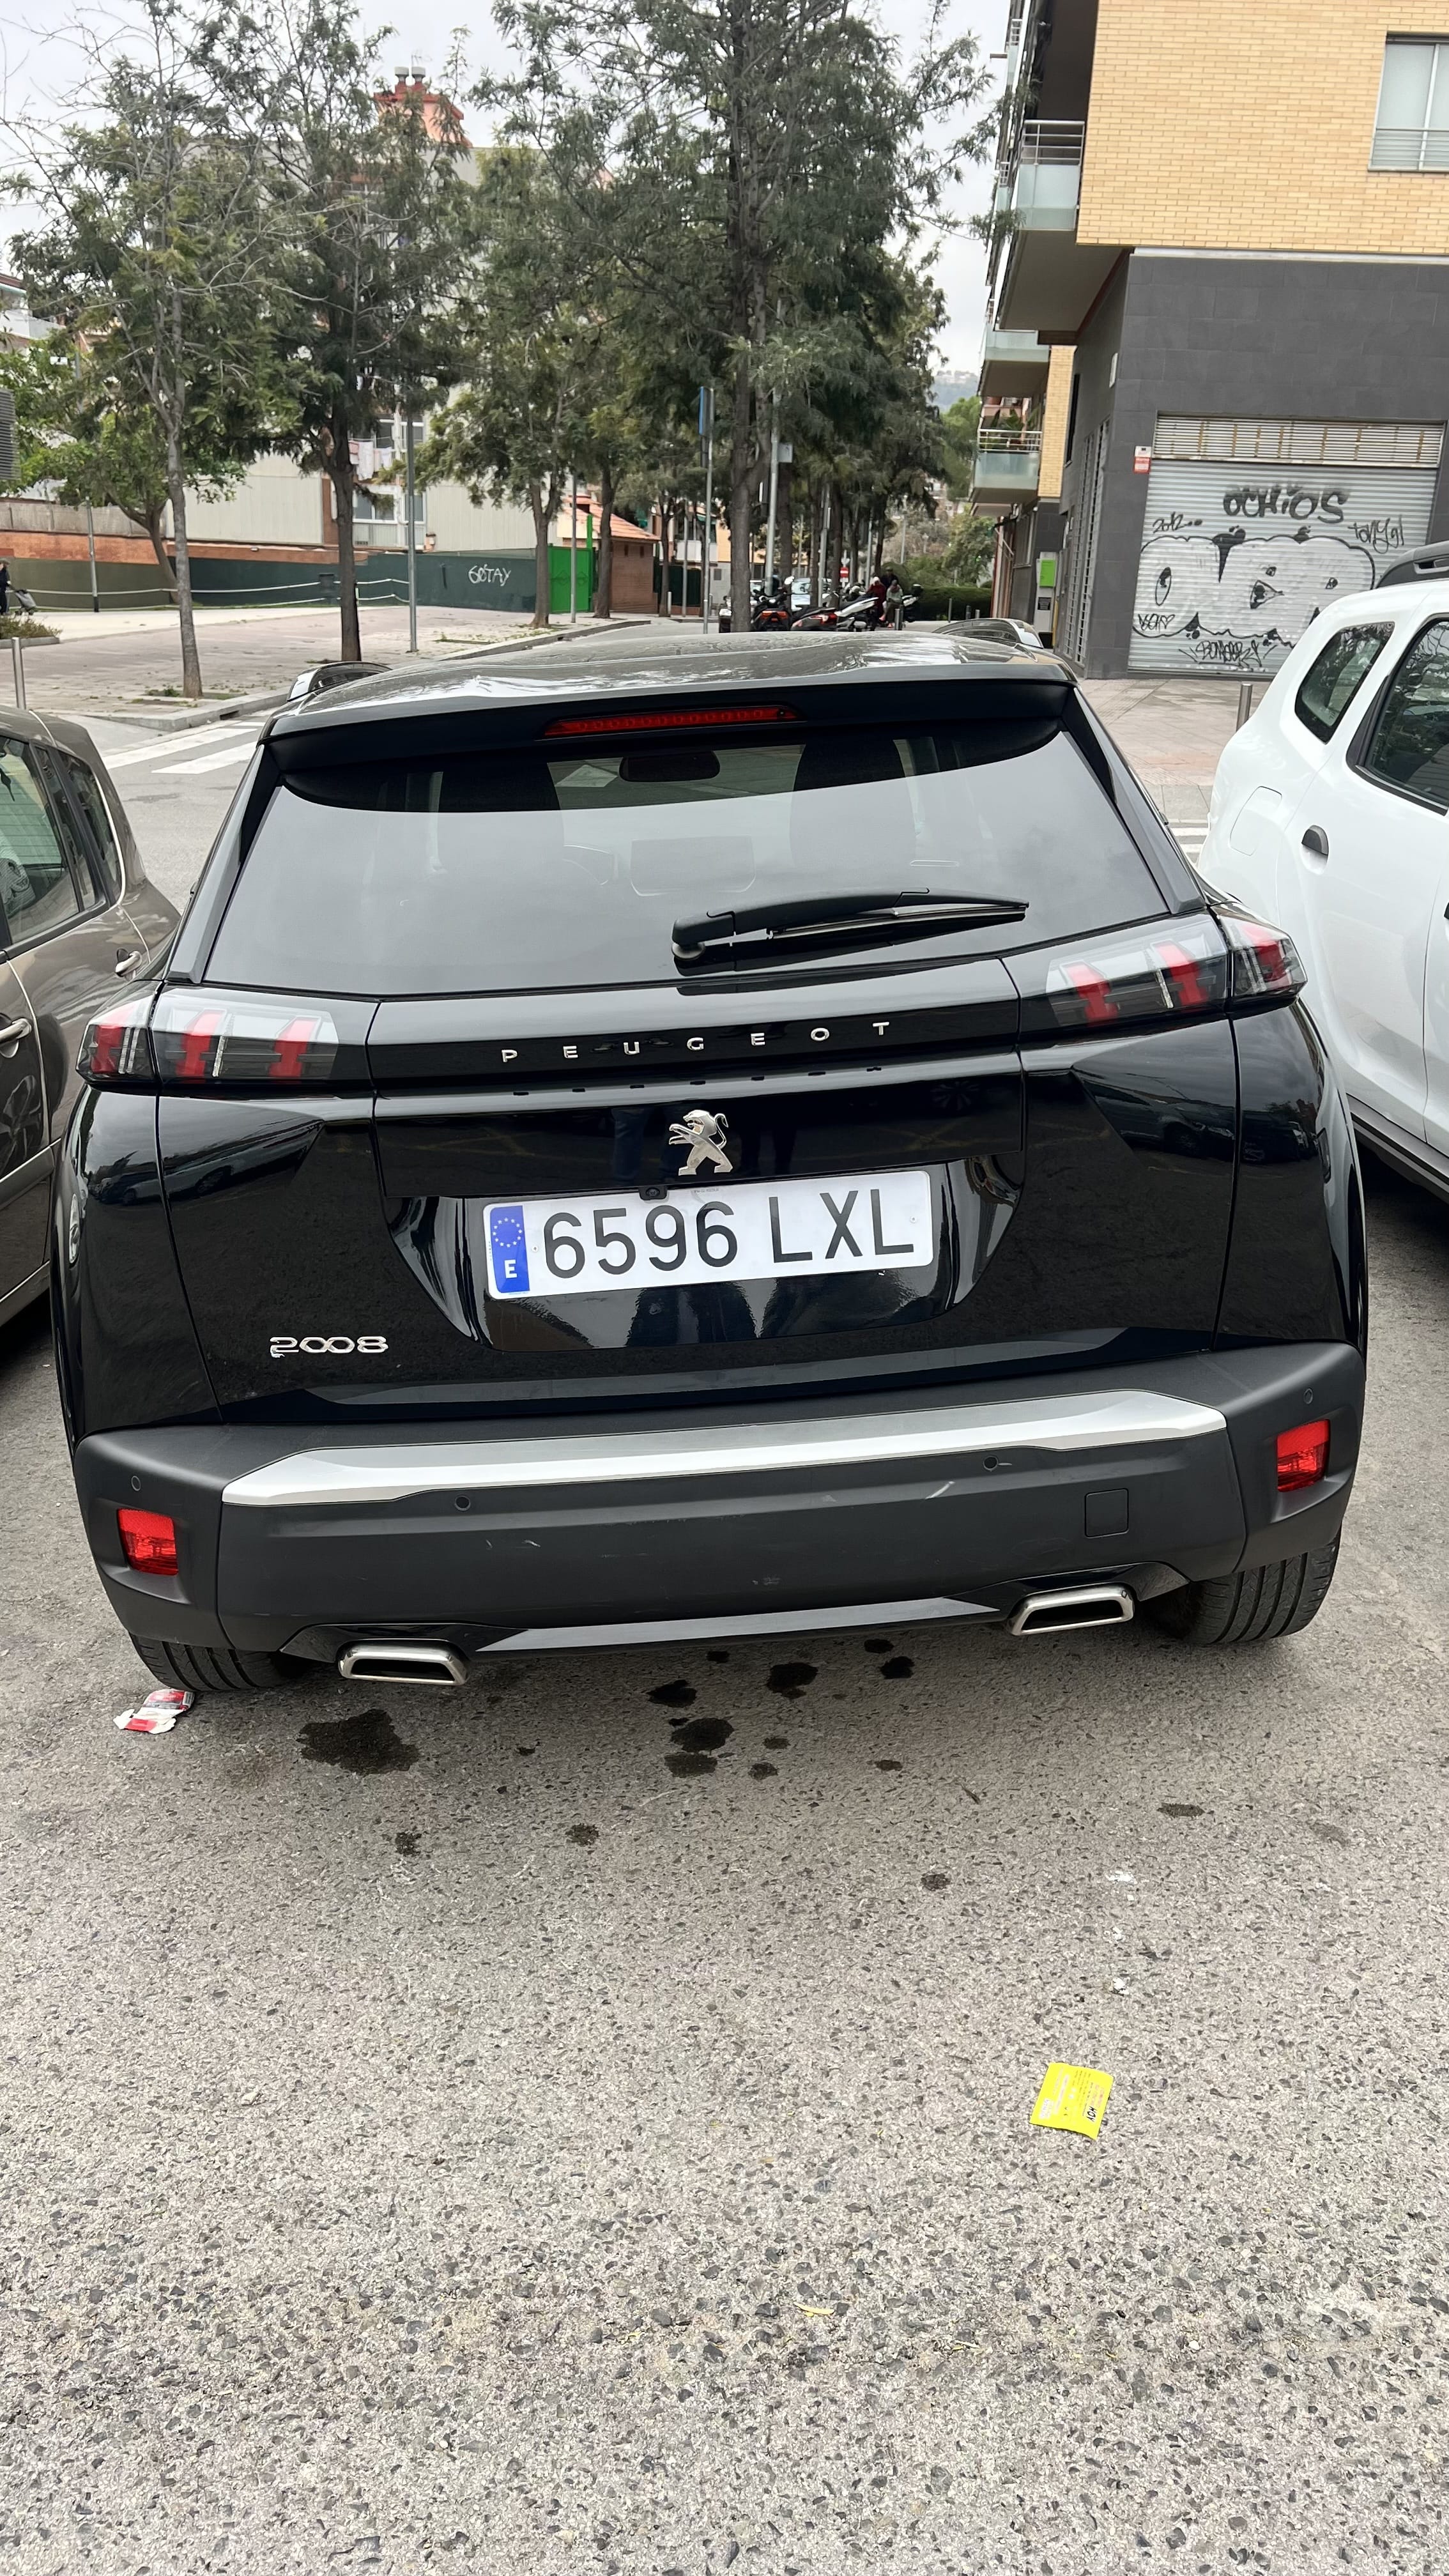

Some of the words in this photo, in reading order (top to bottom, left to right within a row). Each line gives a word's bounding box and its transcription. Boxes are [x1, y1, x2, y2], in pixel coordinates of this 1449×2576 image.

[501, 1022, 889, 1063] PEUGEOT
[543, 1200, 738, 1279] 6596
[768, 1188, 914, 1264] LXL
[504, 1259, 518, 1278] E
[270, 1336, 388, 1358] 2008
